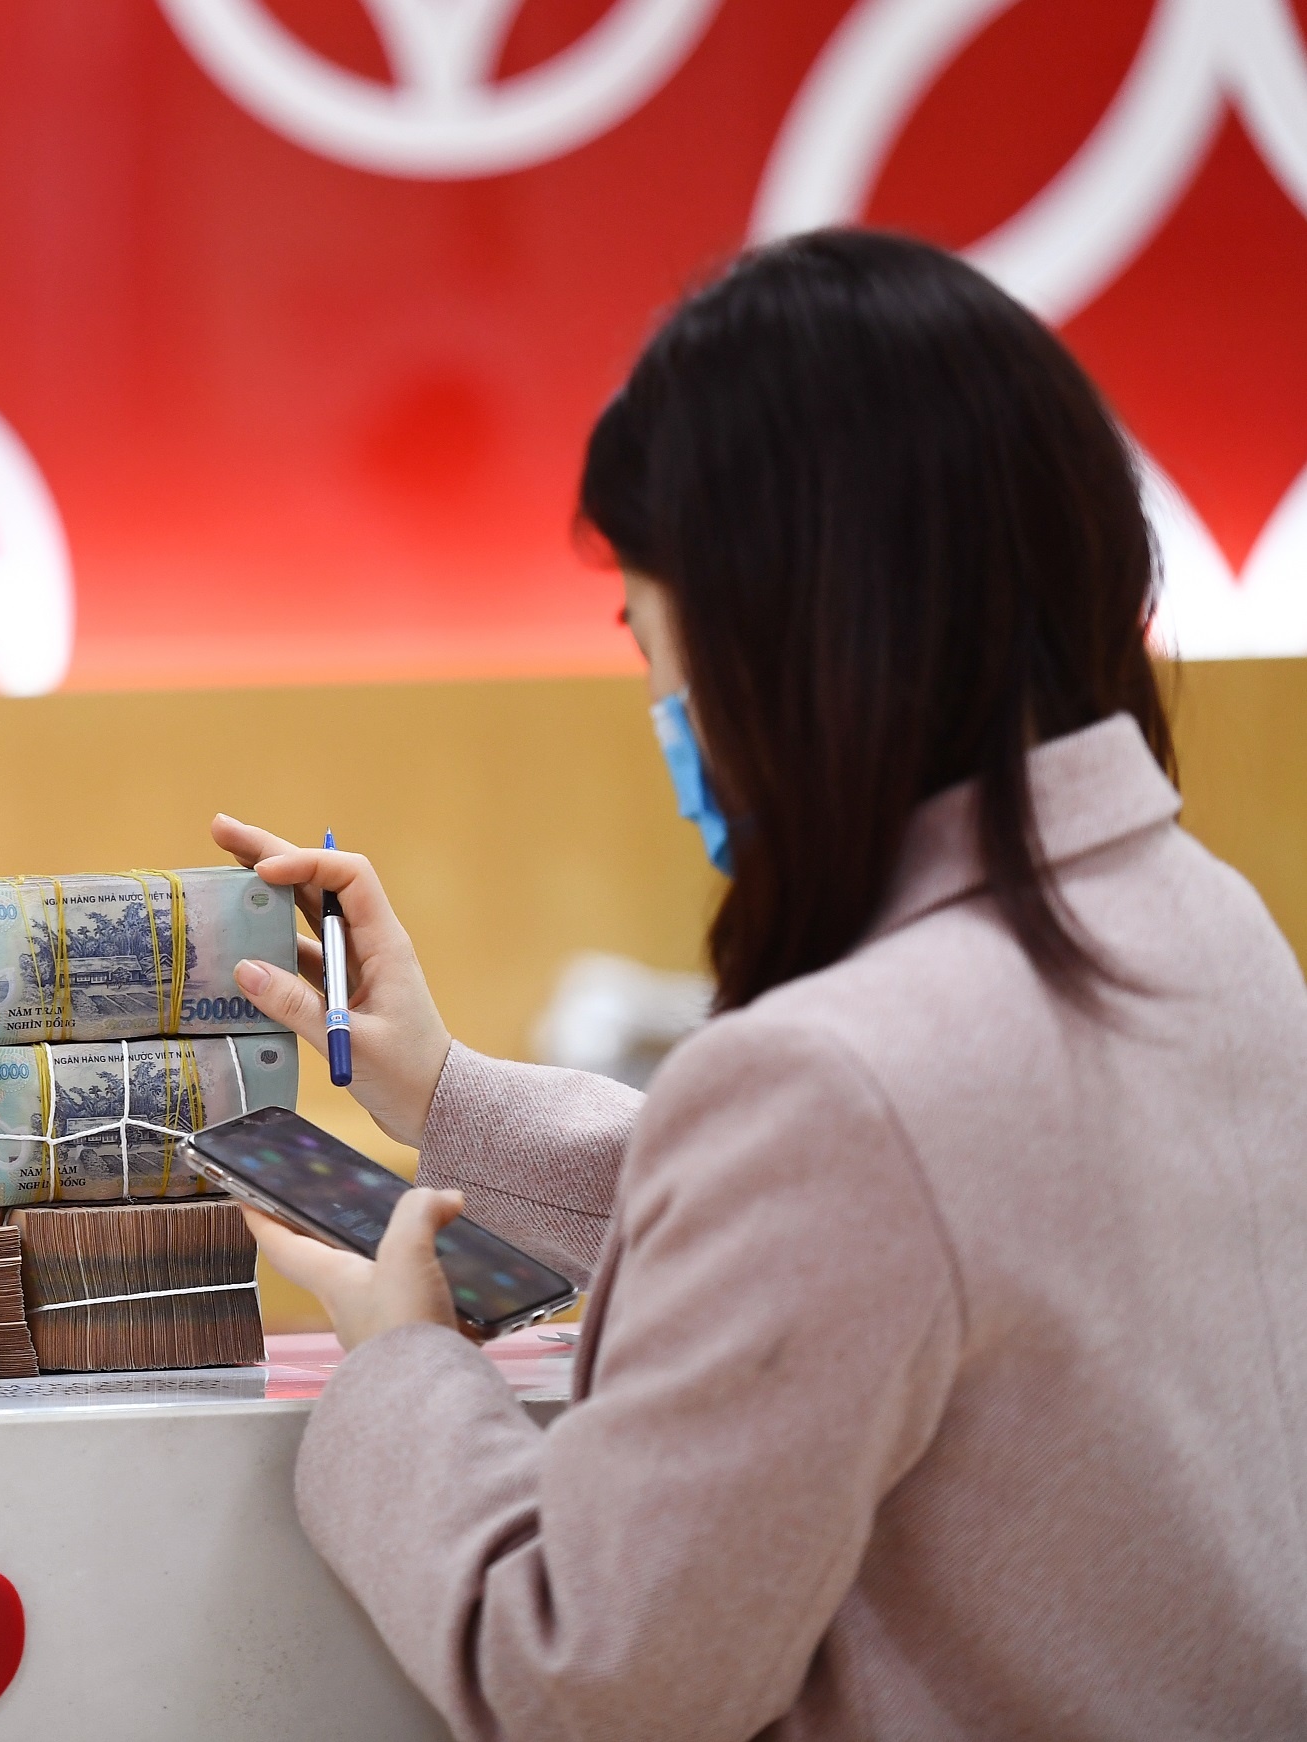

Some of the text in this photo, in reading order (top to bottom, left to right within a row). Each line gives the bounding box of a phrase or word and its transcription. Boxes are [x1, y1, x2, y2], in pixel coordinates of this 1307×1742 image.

[43, 897, 69, 906] NGN
[70, 894, 96, 904] HÀNG
[98, 892, 117, 903] NHÀ
[118, 892, 144, 902] NƯỚC
[166, 891, 186, 900] NM
[8, 1006, 33, 1018] NĂM
[6, 1019, 43, 1031] NGHÌN
[54, 1054, 80, 1065] NGÂN
[81, 1053, 107, 1063] HÀNG
[128, 1051, 154, 1062] NƯỚC
